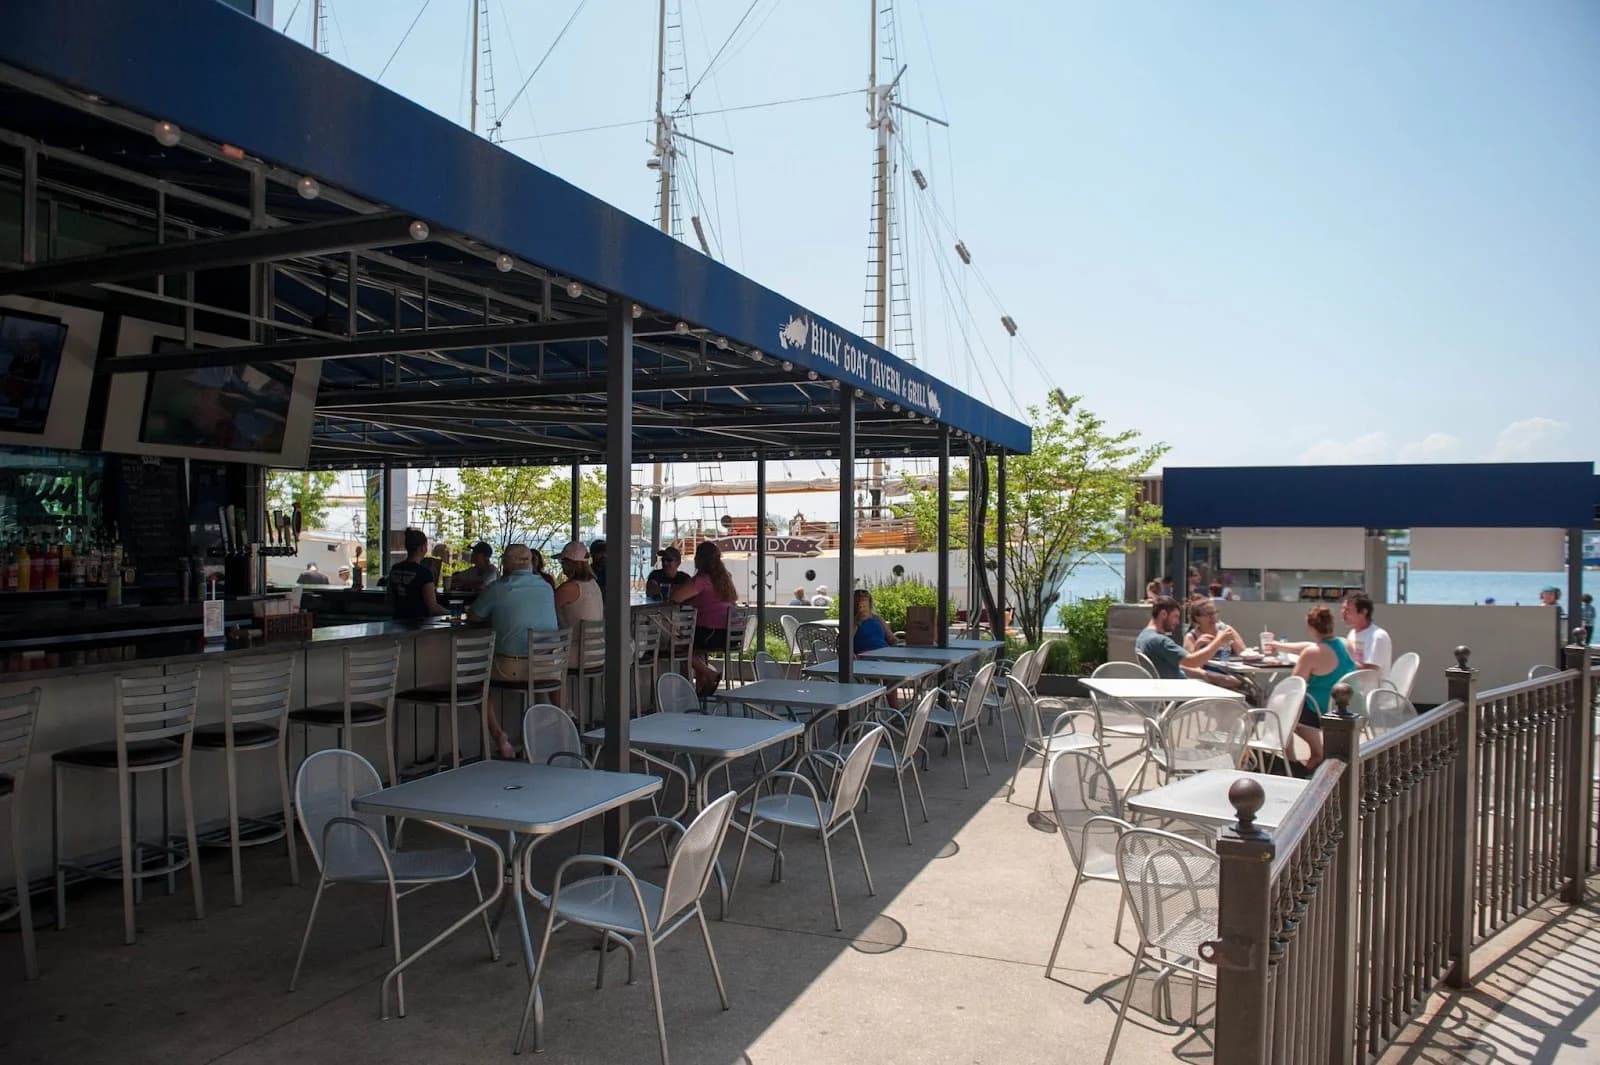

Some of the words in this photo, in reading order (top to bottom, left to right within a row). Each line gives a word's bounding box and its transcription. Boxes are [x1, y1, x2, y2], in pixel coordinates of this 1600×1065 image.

[811, 320, 841, 367] BILLY
[844, 342, 868, 380] GOAT
[870, 358, 900, 397] TAVERN
[901, 378, 907, 398] &
[907, 377, 927, 409] GRILL
